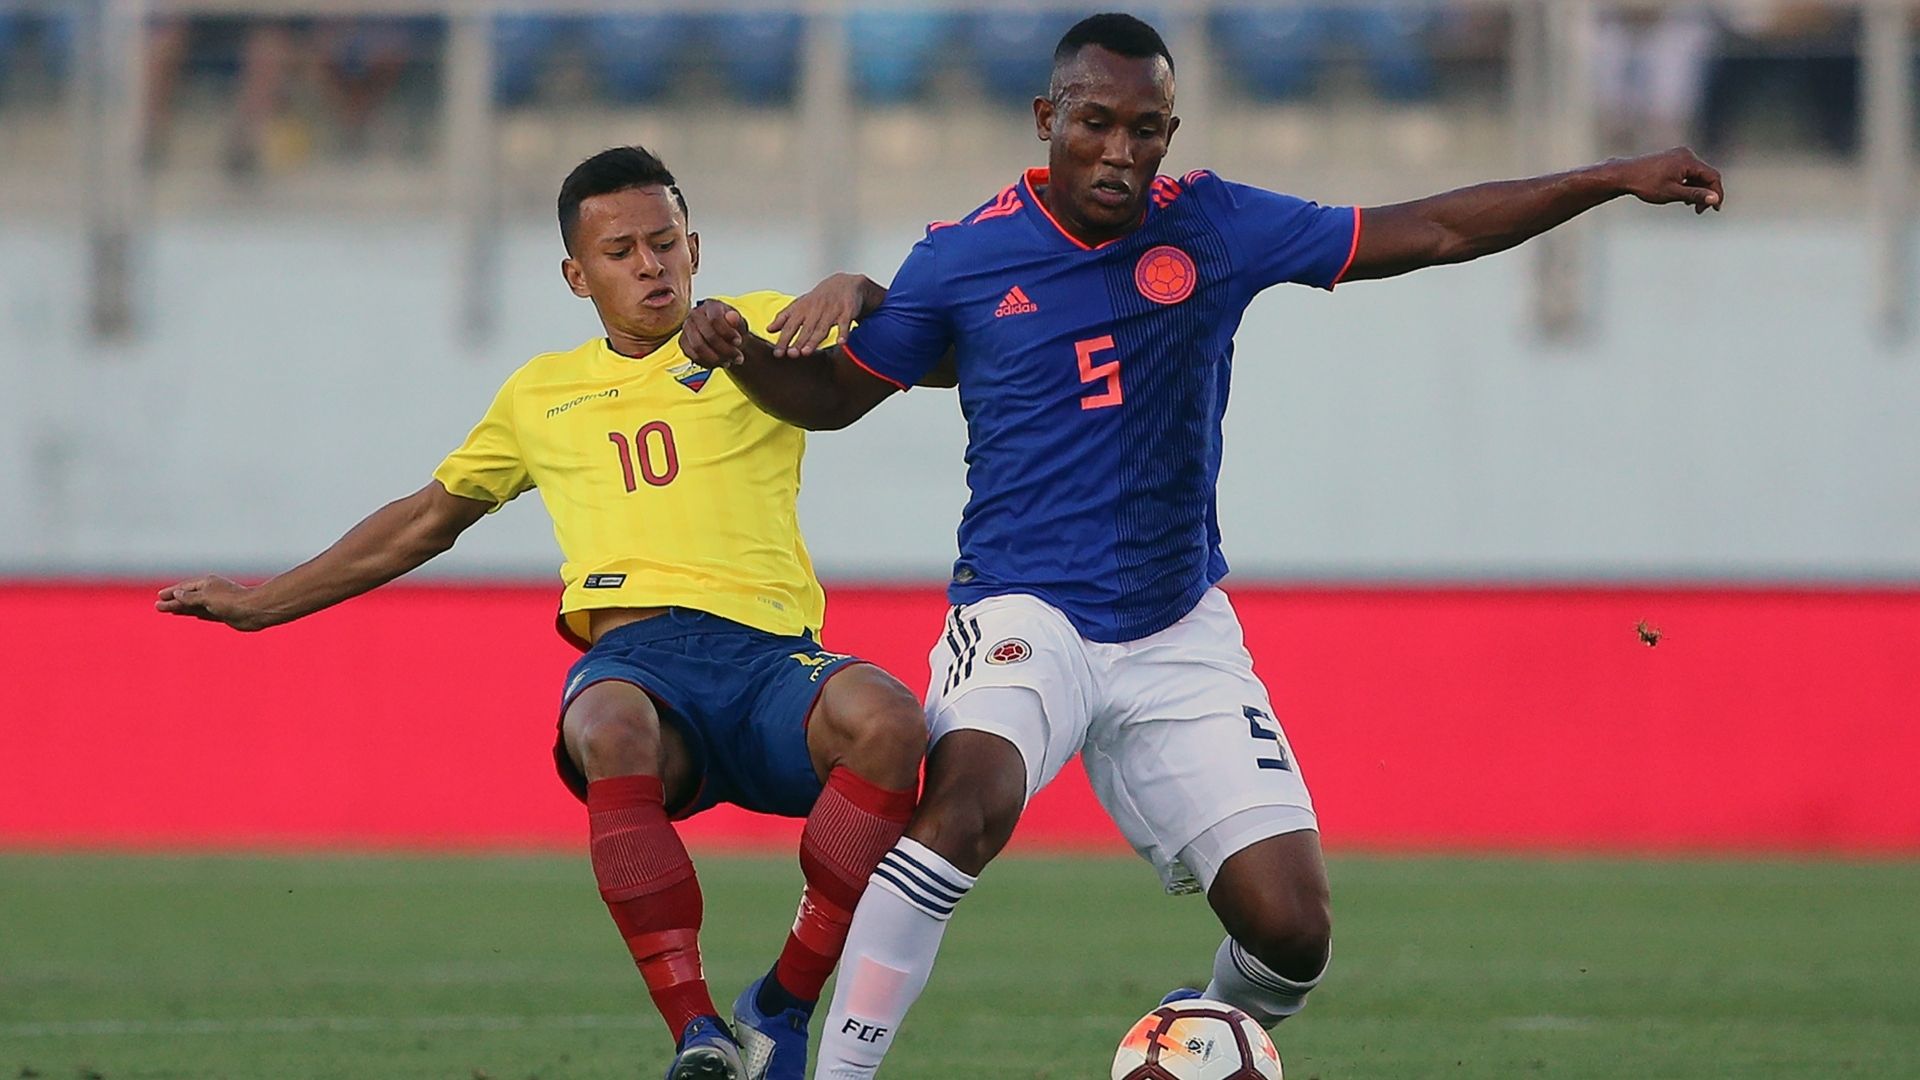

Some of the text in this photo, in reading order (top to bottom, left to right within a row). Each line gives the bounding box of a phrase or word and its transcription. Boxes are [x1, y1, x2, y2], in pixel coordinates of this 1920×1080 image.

[994, 301, 1037, 318] adidas
[1074, 335, 1123, 410] 5
[608, 420, 680, 493] 10
[1241, 704, 1293, 773] 5
[841, 1018, 888, 1043] FCF
